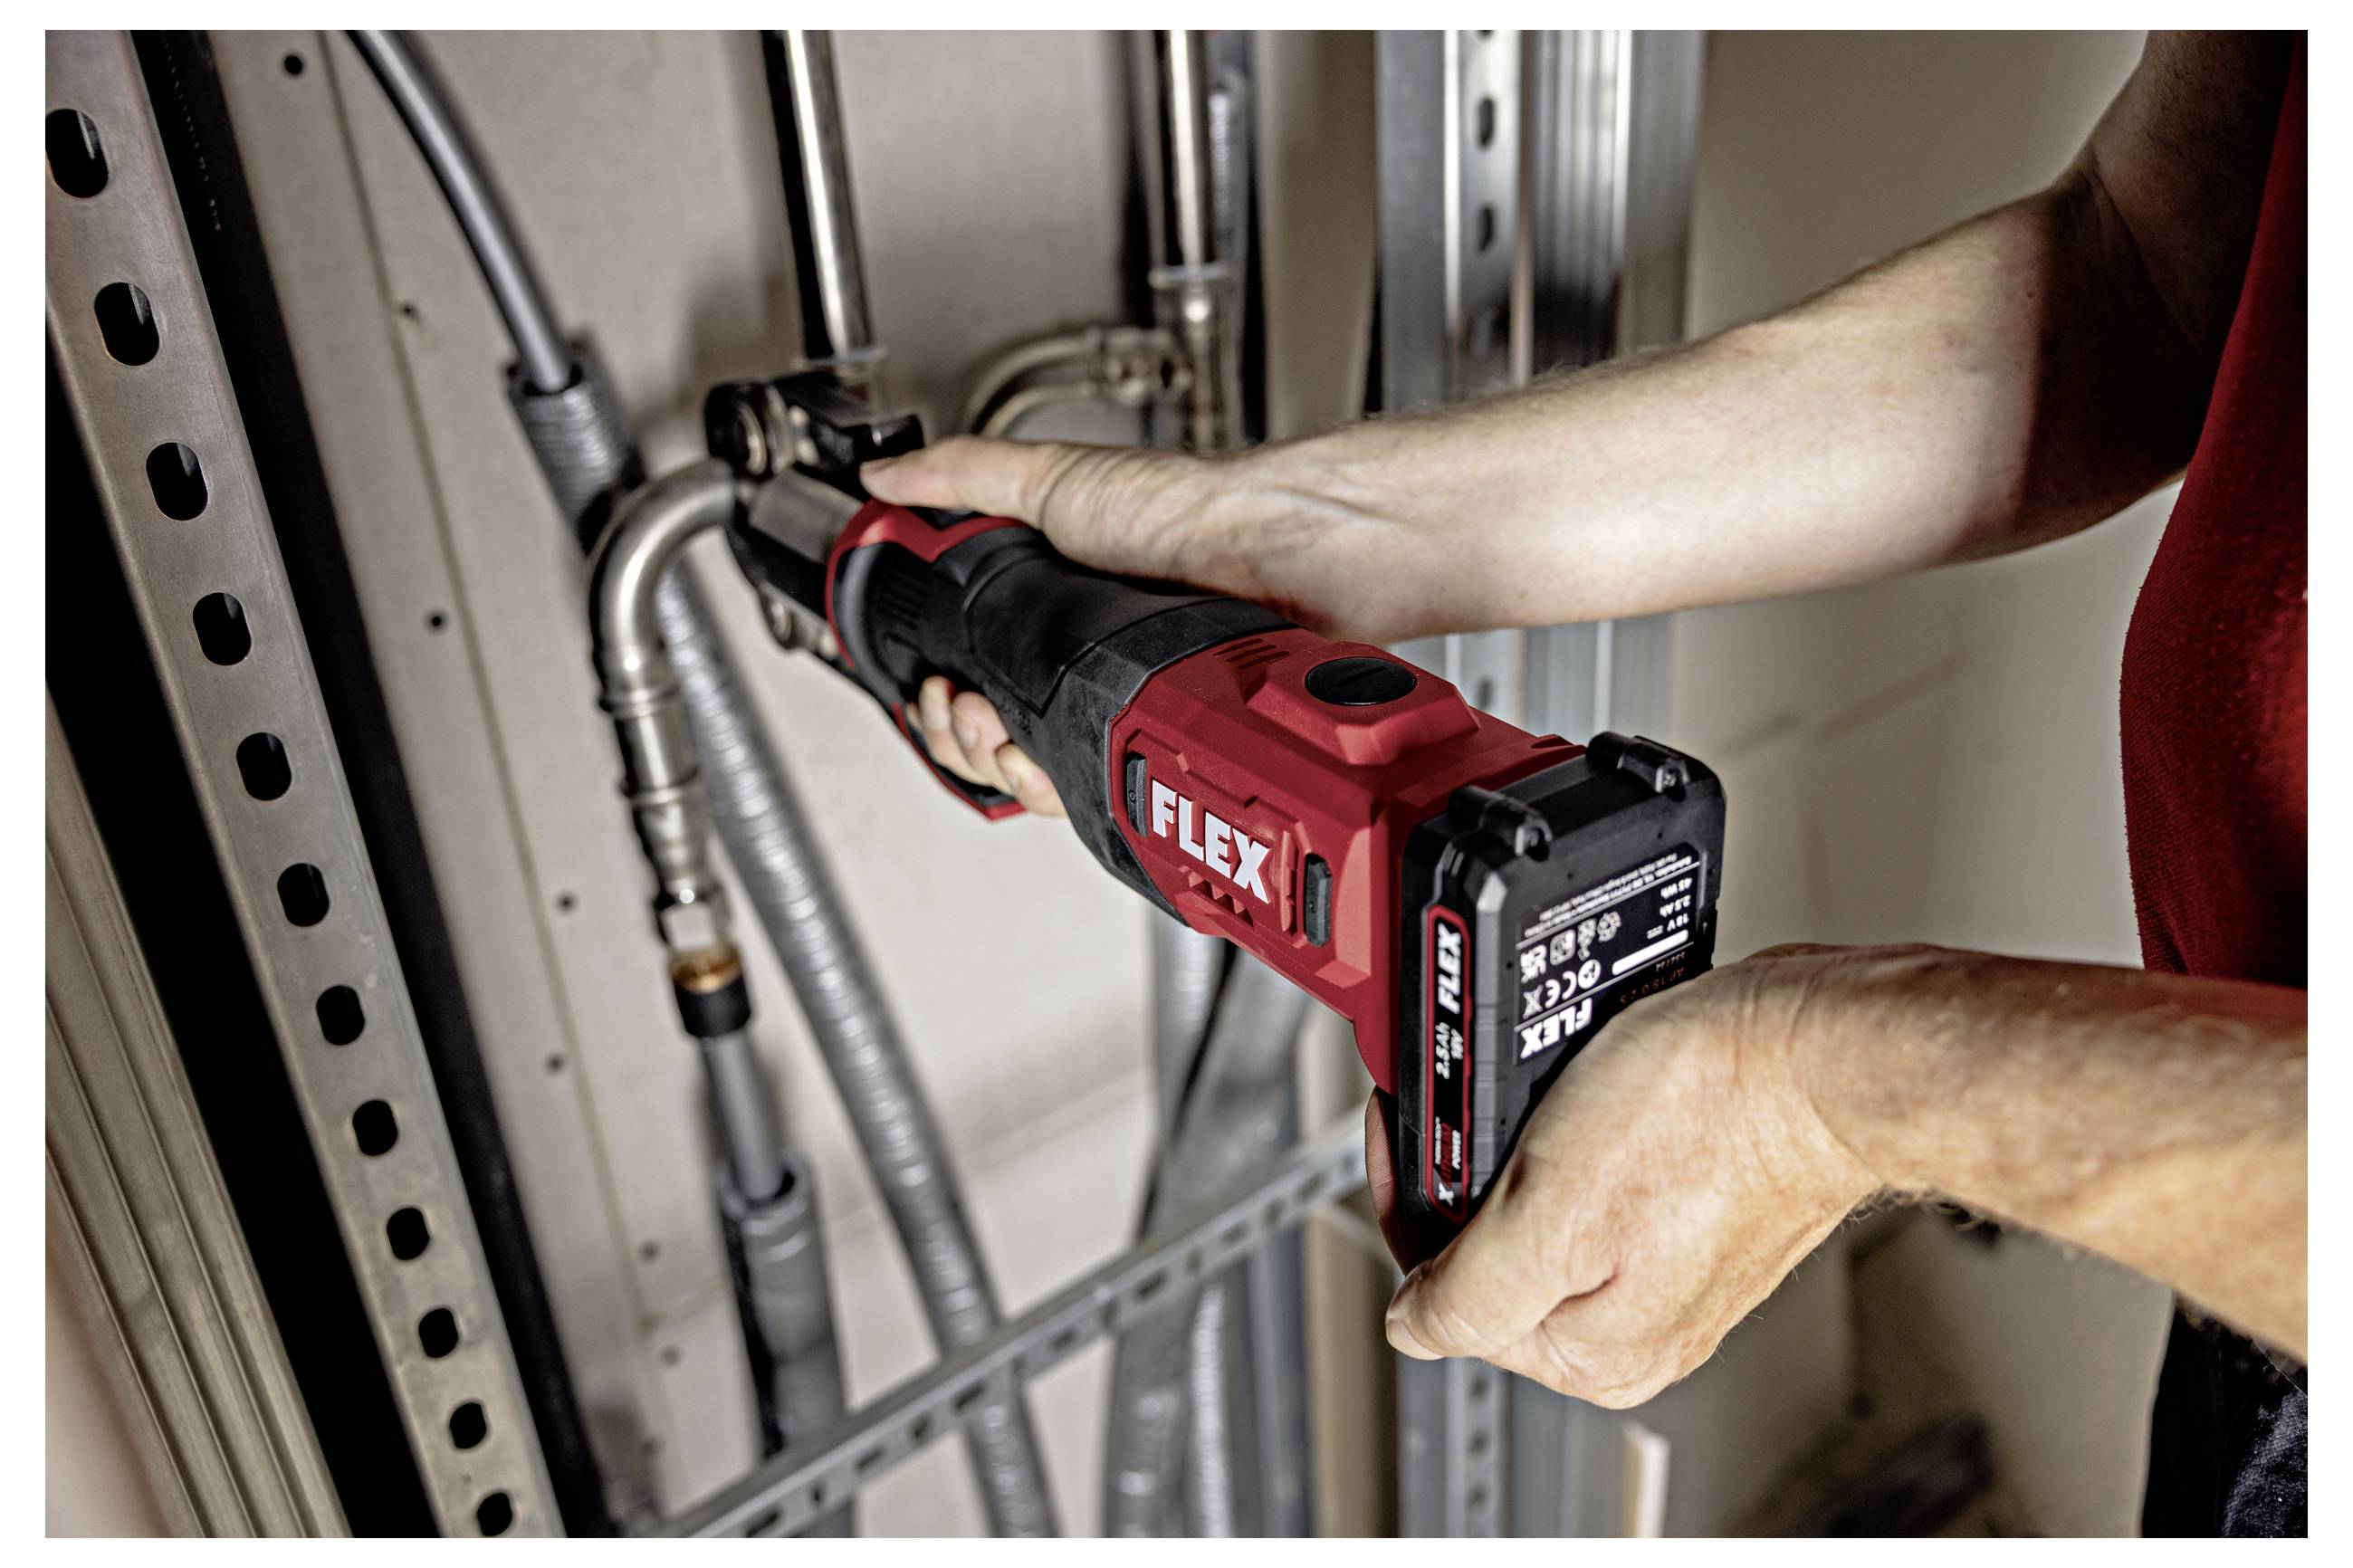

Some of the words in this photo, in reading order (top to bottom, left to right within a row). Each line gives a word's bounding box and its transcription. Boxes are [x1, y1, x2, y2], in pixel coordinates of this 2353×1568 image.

[1152, 779, 1270, 904] FLEX
[1438, 923, 1461, 1014] FLEX
[1520, 997, 1593, 1059] FLEX
[1452, 1130, 1461, 1170] POWER
